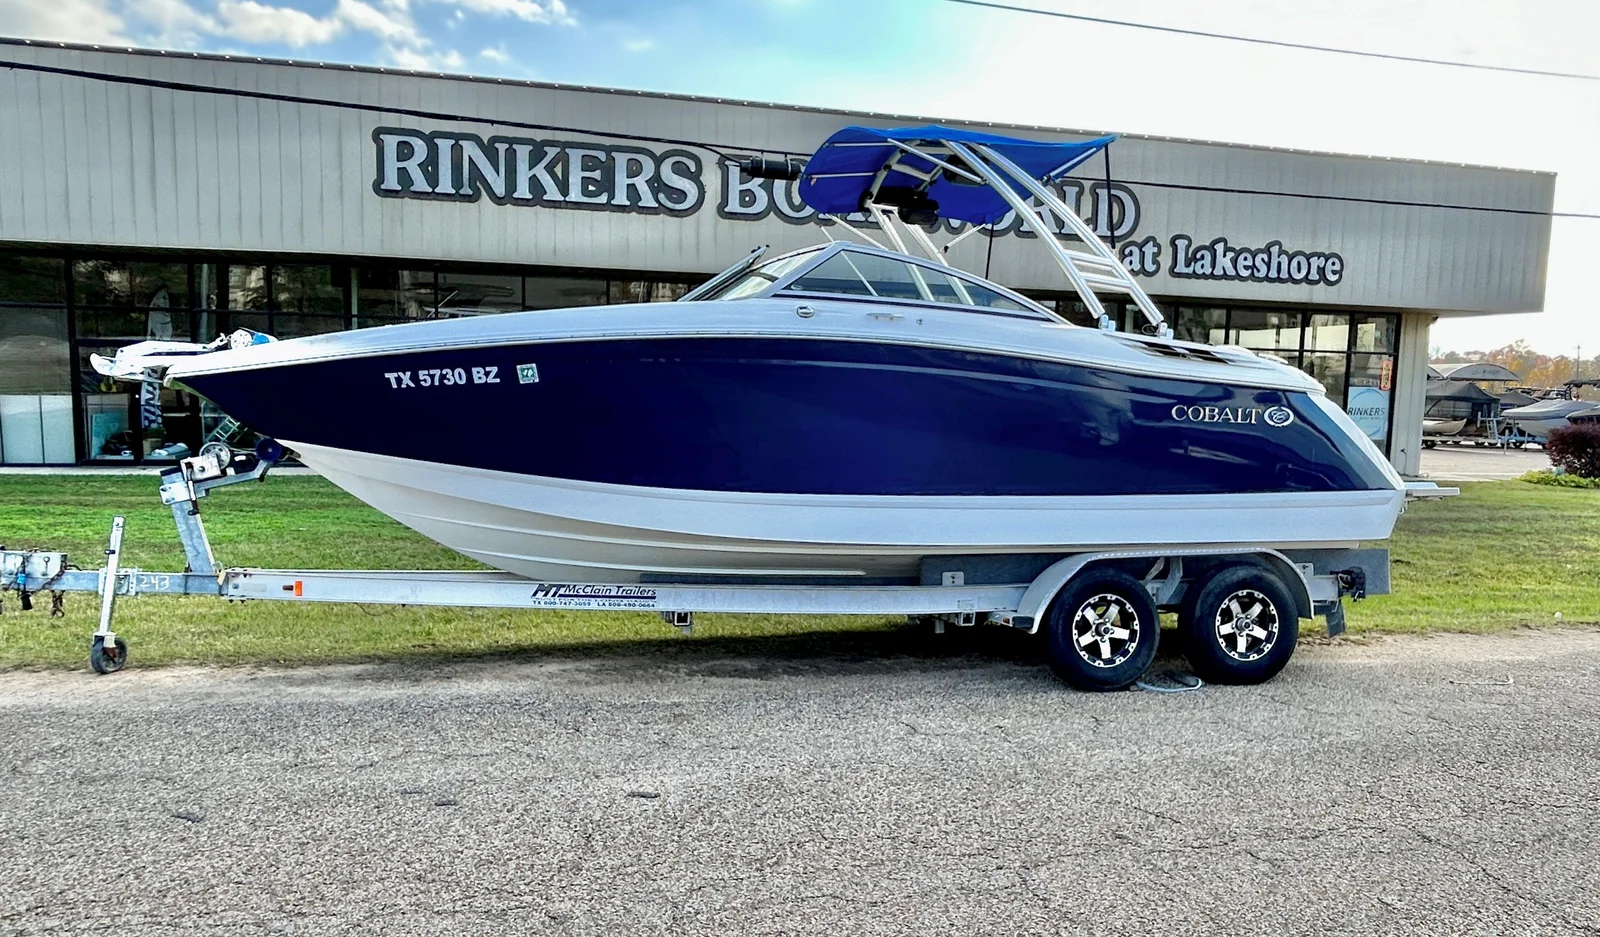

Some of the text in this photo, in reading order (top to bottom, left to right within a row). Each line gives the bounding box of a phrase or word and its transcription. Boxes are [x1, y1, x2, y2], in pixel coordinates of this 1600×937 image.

[378, 132, 700, 212] RINKERS
[1122, 238, 1341, 282] at Lakeshore
[384, 371, 416, 389] TX
[418, 367, 467, 387] 5730
[471, 366, 500, 384] BZ
[1171, 404, 1262, 425] COBALT
[1347, 407, 1386, 416] RINKERS
[139, 575, 170, 590] 243
[563, 584, 657, 596] McClain Trailers
